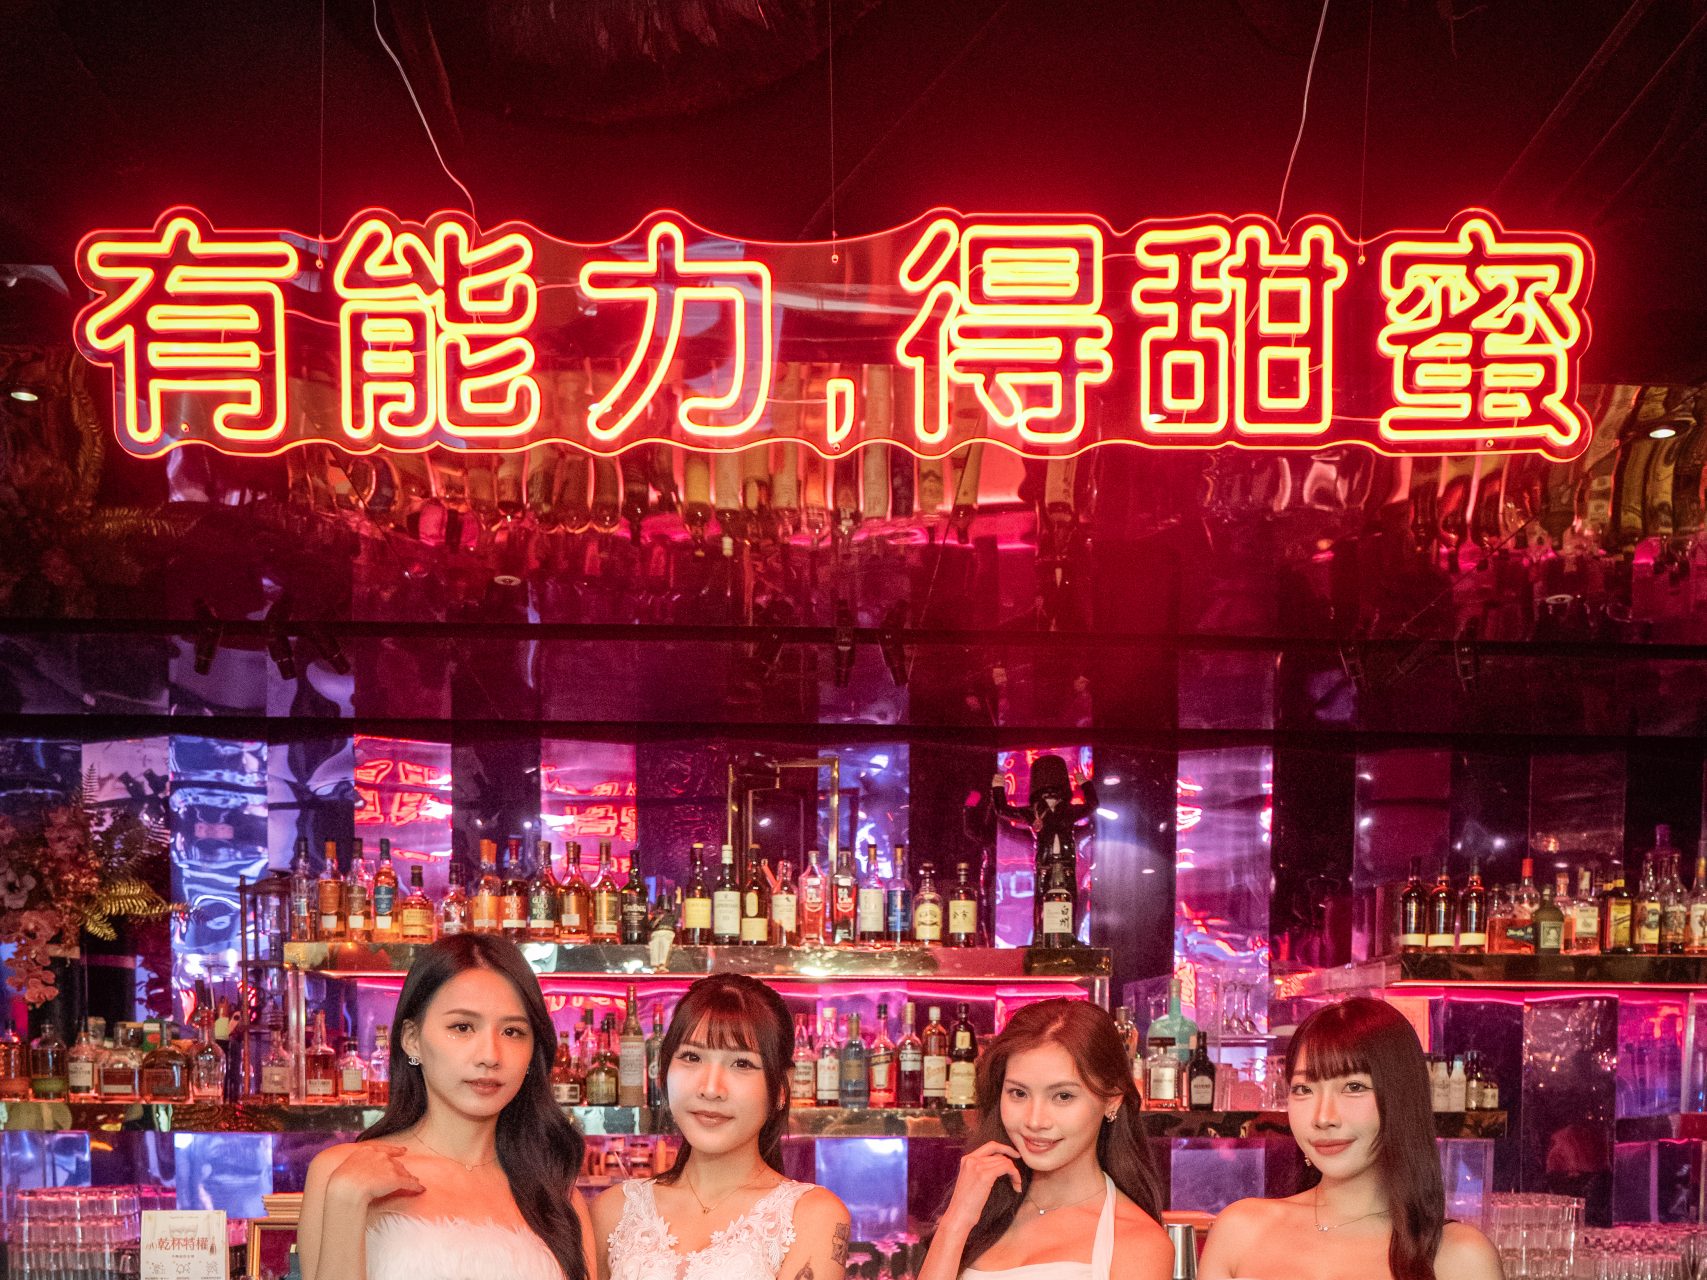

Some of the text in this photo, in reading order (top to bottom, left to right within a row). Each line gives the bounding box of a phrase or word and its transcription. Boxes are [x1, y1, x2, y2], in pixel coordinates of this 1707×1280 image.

[84, 214, 1586, 444] 有能力,得甜蜜
[158, 1237, 208, 1251] 乾杯特權
